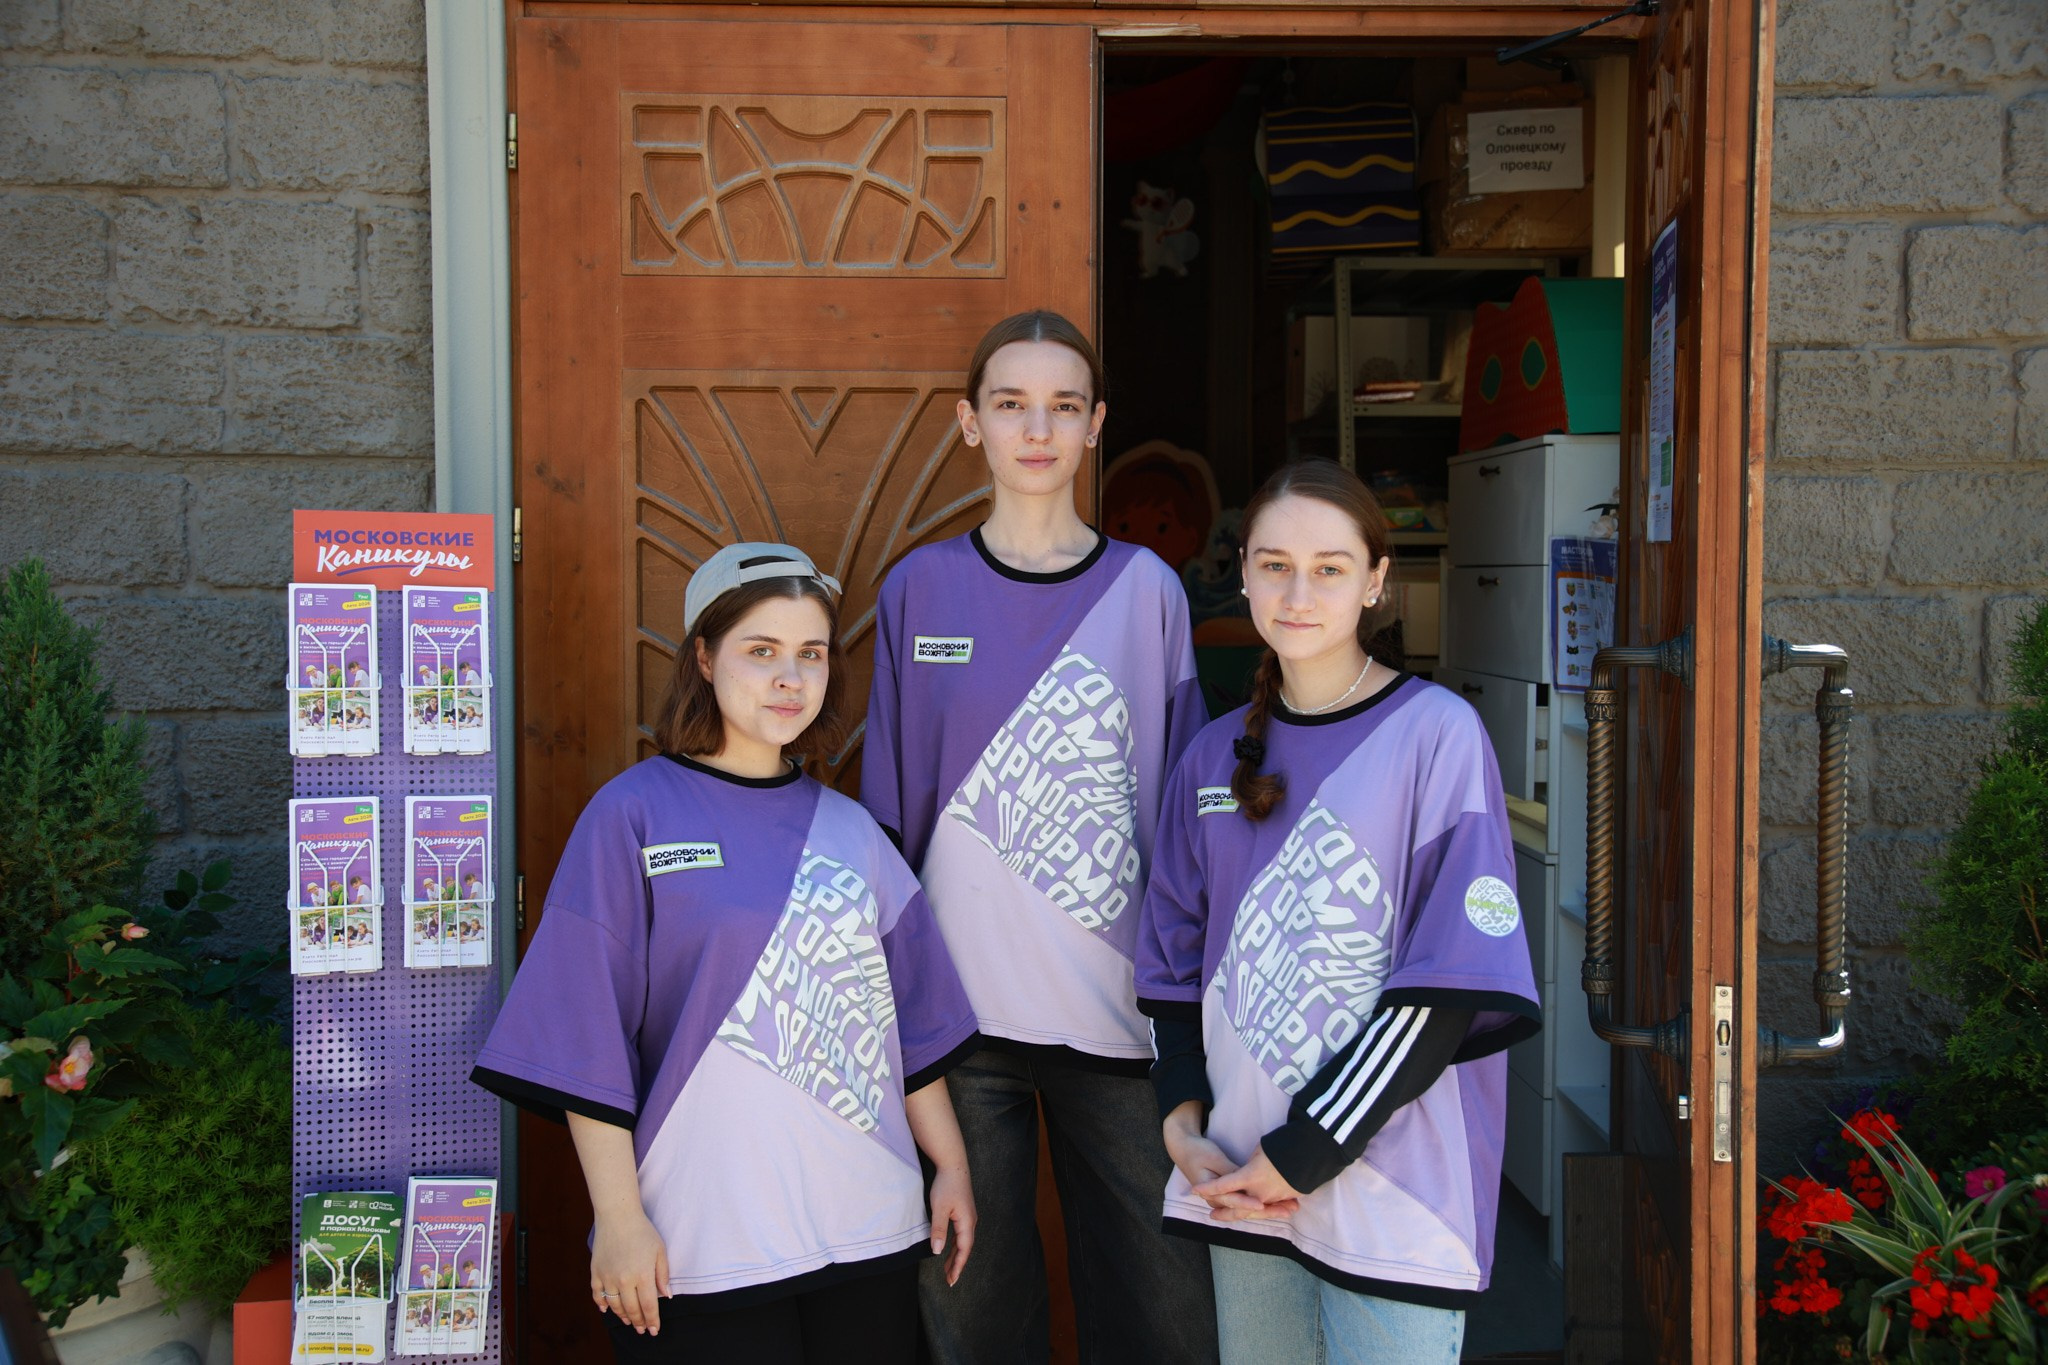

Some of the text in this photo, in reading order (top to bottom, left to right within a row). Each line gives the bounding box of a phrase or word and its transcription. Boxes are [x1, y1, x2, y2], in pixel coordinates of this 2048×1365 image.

[1497, 125, 1555, 136] Сквер по
[1486, 142, 1566, 154] Олонецкому
[1500, 160, 1552, 173] проезду
[314, 529, 474, 546] МОСКОВСКИЕ
[317, 544, 474, 577] Каникулы
[415, 625, 476, 638] Каникулы
[919, 642, 969, 650] МОСКОВСКИЙ
[301, 832, 368, 841] МОСКОВСКИЕ
[649, 848, 716, 862] МОСКОВСКИЙ
[320, 1215, 380, 1226] ДОСУГ
